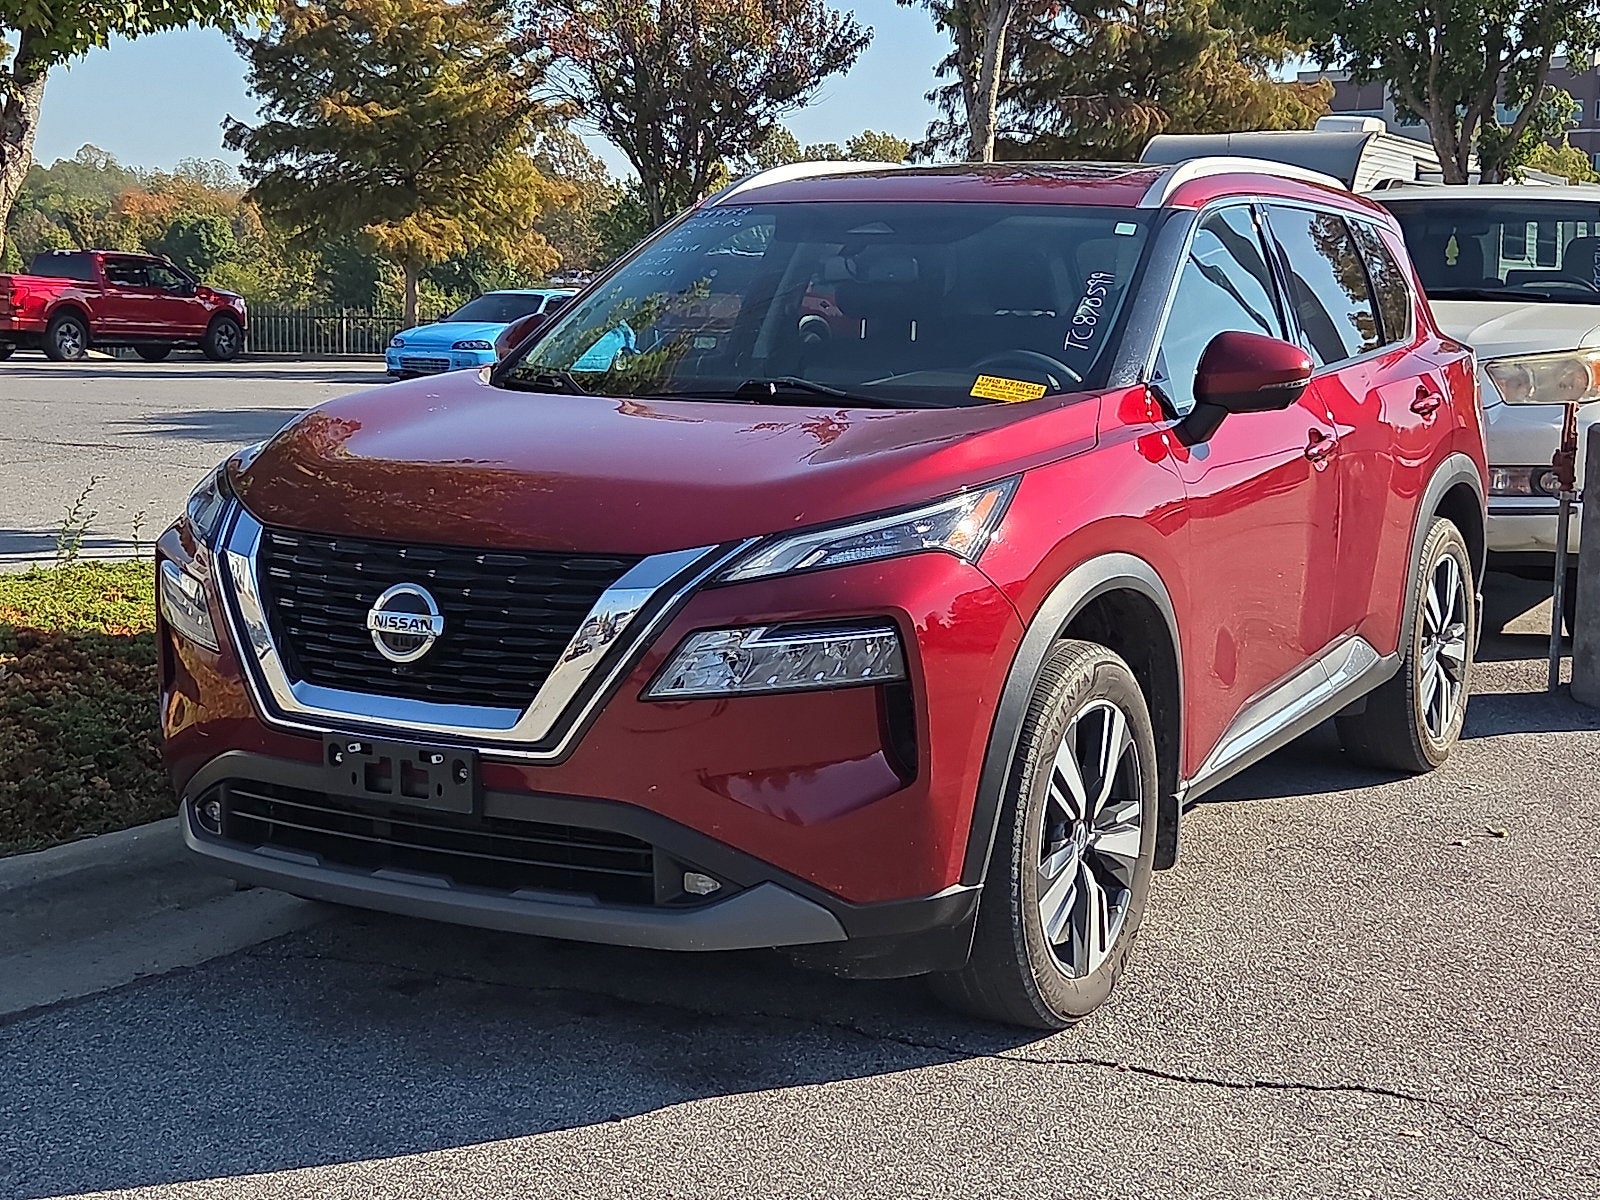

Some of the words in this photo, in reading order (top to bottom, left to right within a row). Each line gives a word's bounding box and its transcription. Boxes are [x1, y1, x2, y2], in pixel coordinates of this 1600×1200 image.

[981, 376, 1001, 385] THIS
[1004, 380, 1044, 391] VEHICLE
[374, 614, 433, 631] NISSAN
[1050, 672, 1091, 738] ALENZA
